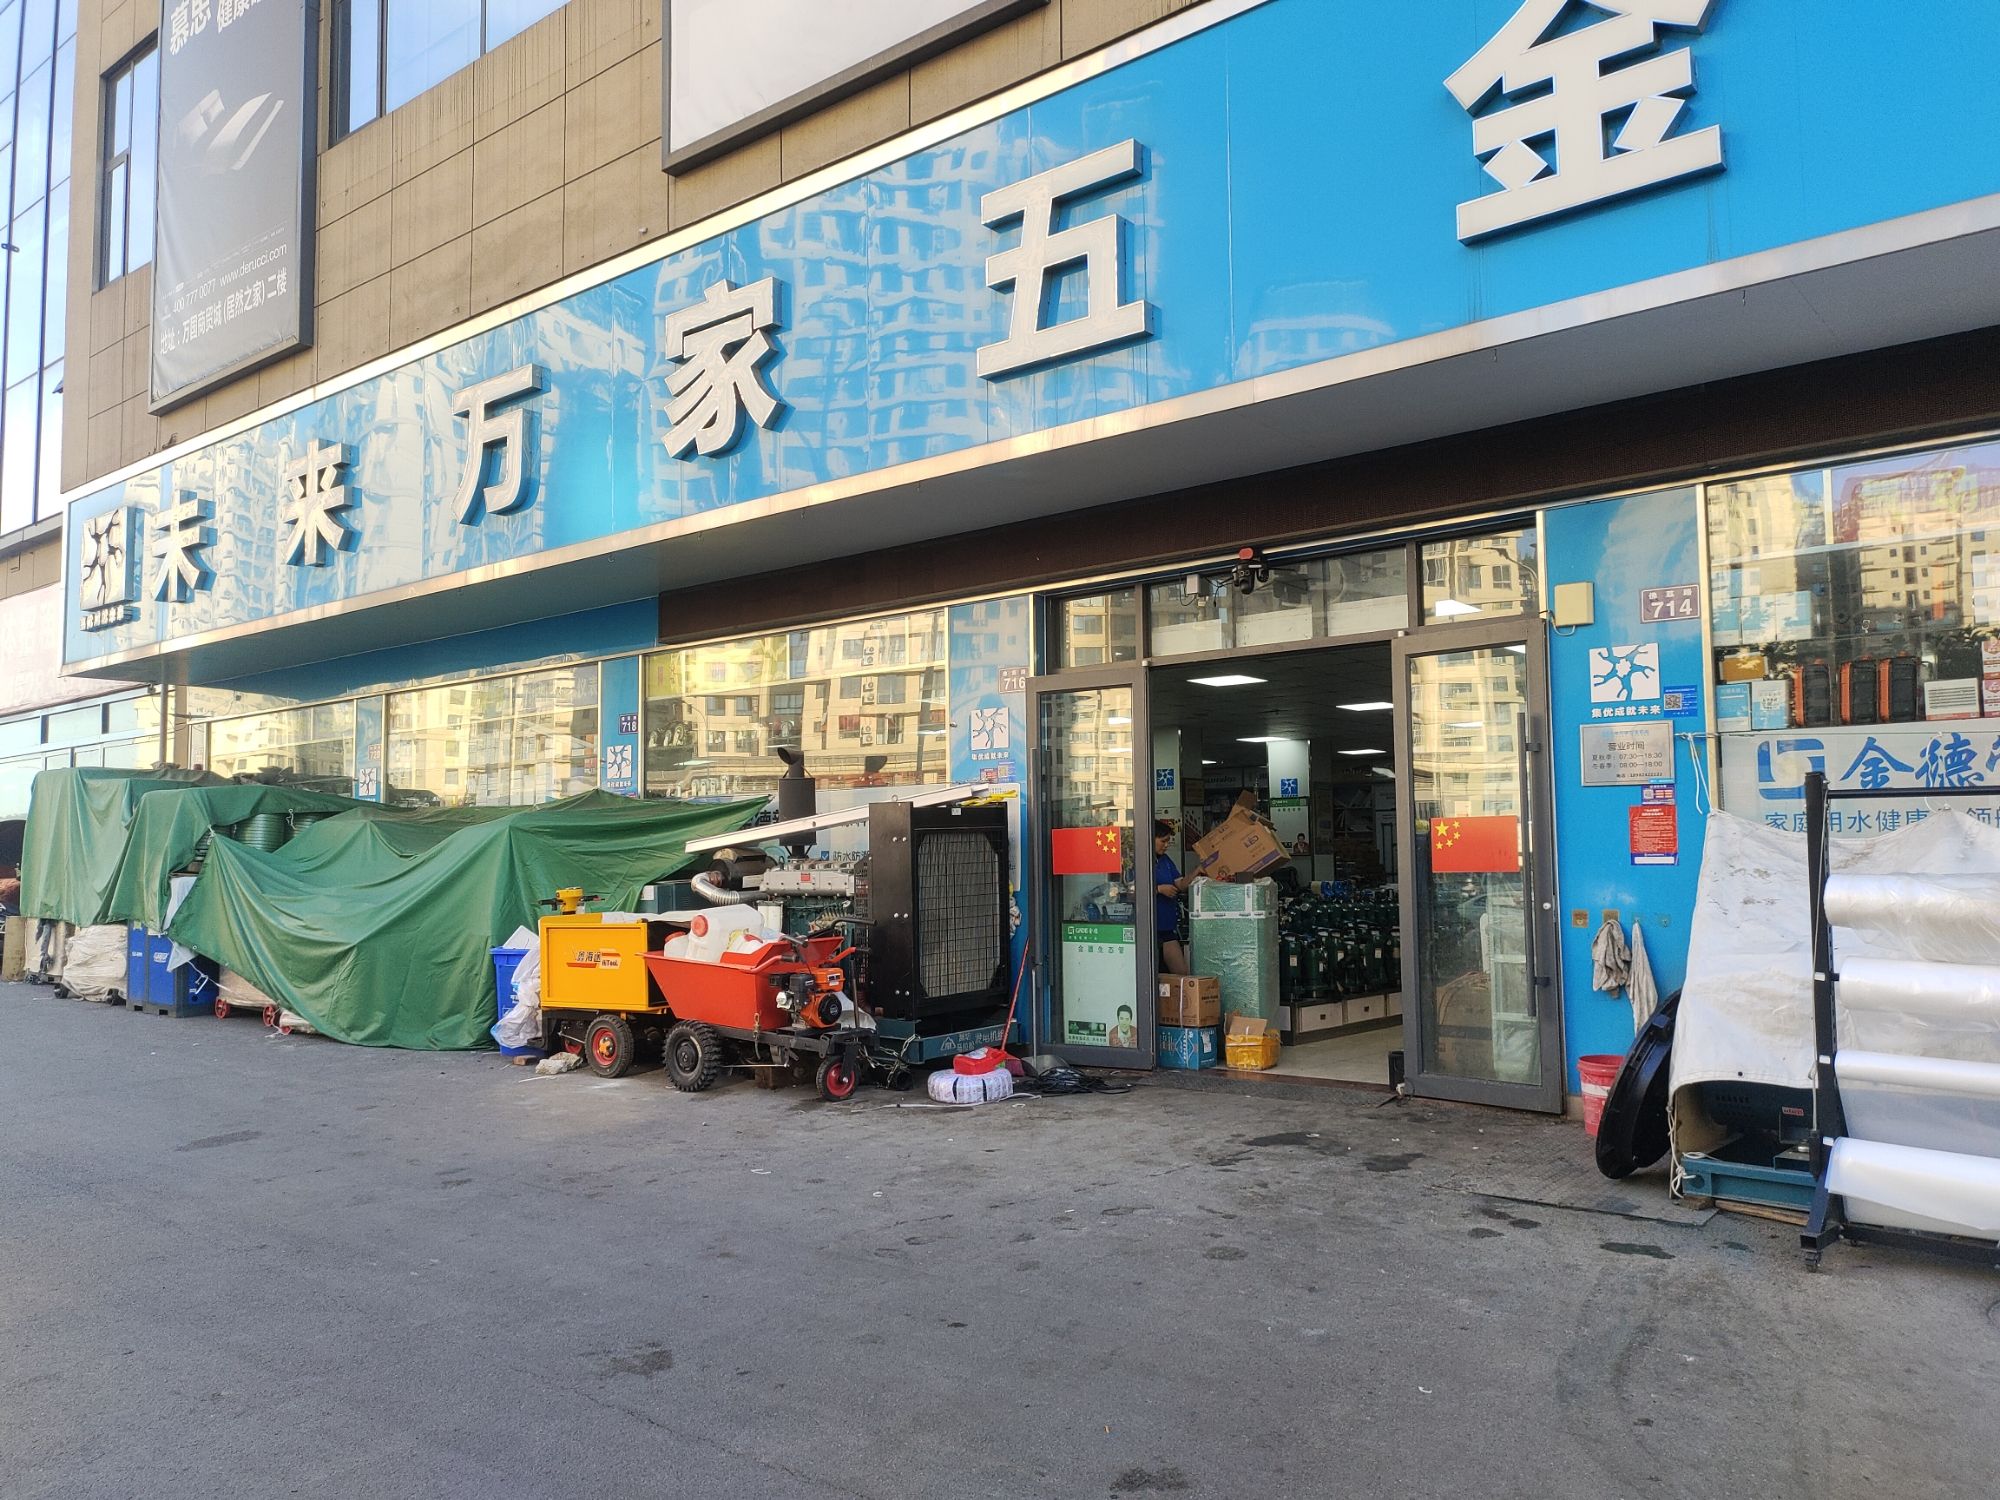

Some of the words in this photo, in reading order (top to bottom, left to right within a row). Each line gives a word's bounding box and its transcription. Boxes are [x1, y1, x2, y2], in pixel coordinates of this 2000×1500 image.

[220, 243, 288, 287] www.derucci.com
[151, 0, 1727, 603] 未来万家五金
[1651, 598, 1693, 618] 714
[1003, 676, 1026, 691] 716
[1591, 705, 1661, 718] 集优成就未来
[622, 721, 638, 732] 718
[1608, 740, 1645, 751] 营业时间
